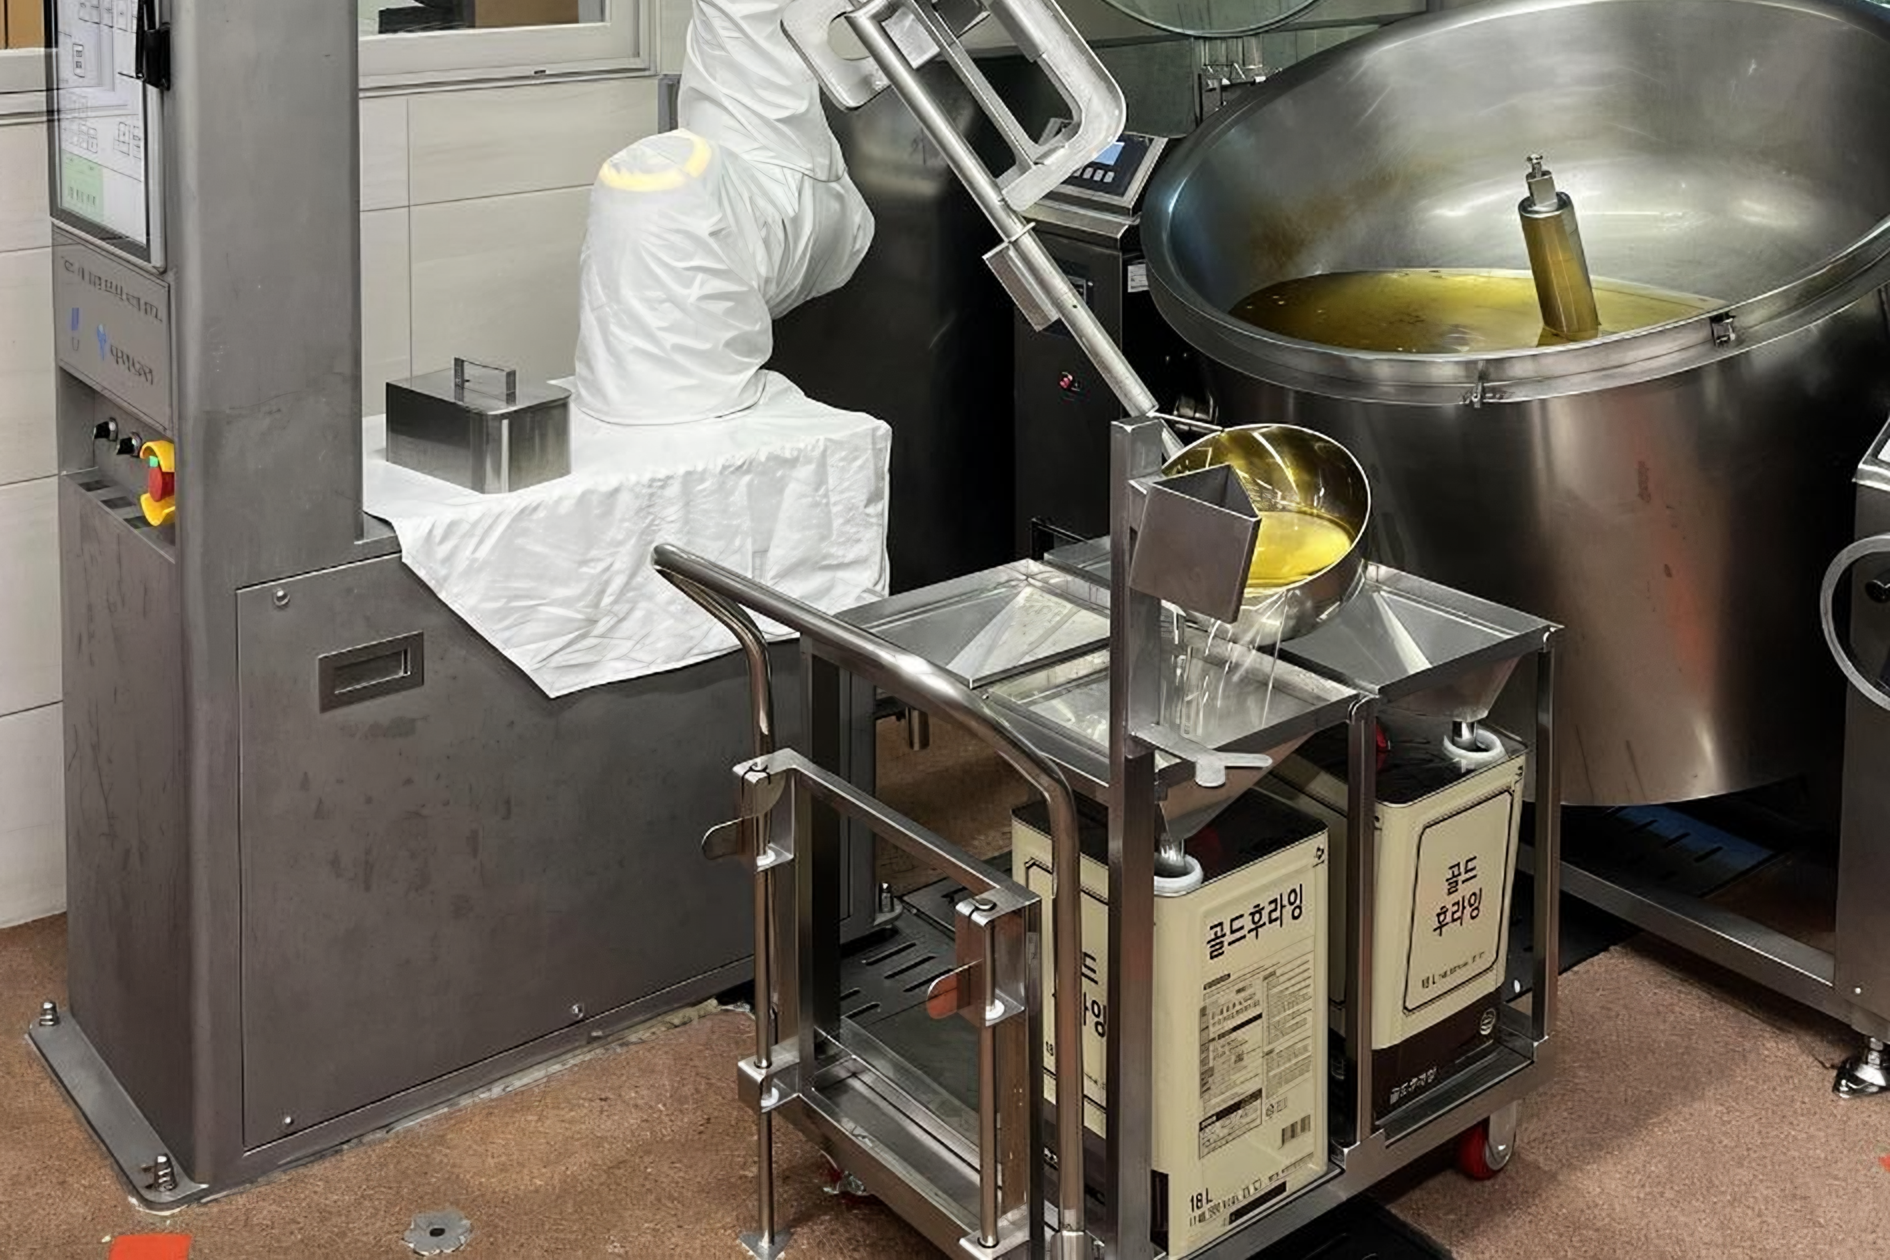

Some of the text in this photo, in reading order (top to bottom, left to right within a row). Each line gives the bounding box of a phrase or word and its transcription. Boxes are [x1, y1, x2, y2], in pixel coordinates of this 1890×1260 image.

[1445, 855, 1478, 896] 골드
[1206, 883, 1303, 960] 골드후라잉
[1432, 886, 1483, 937] 후라잉
